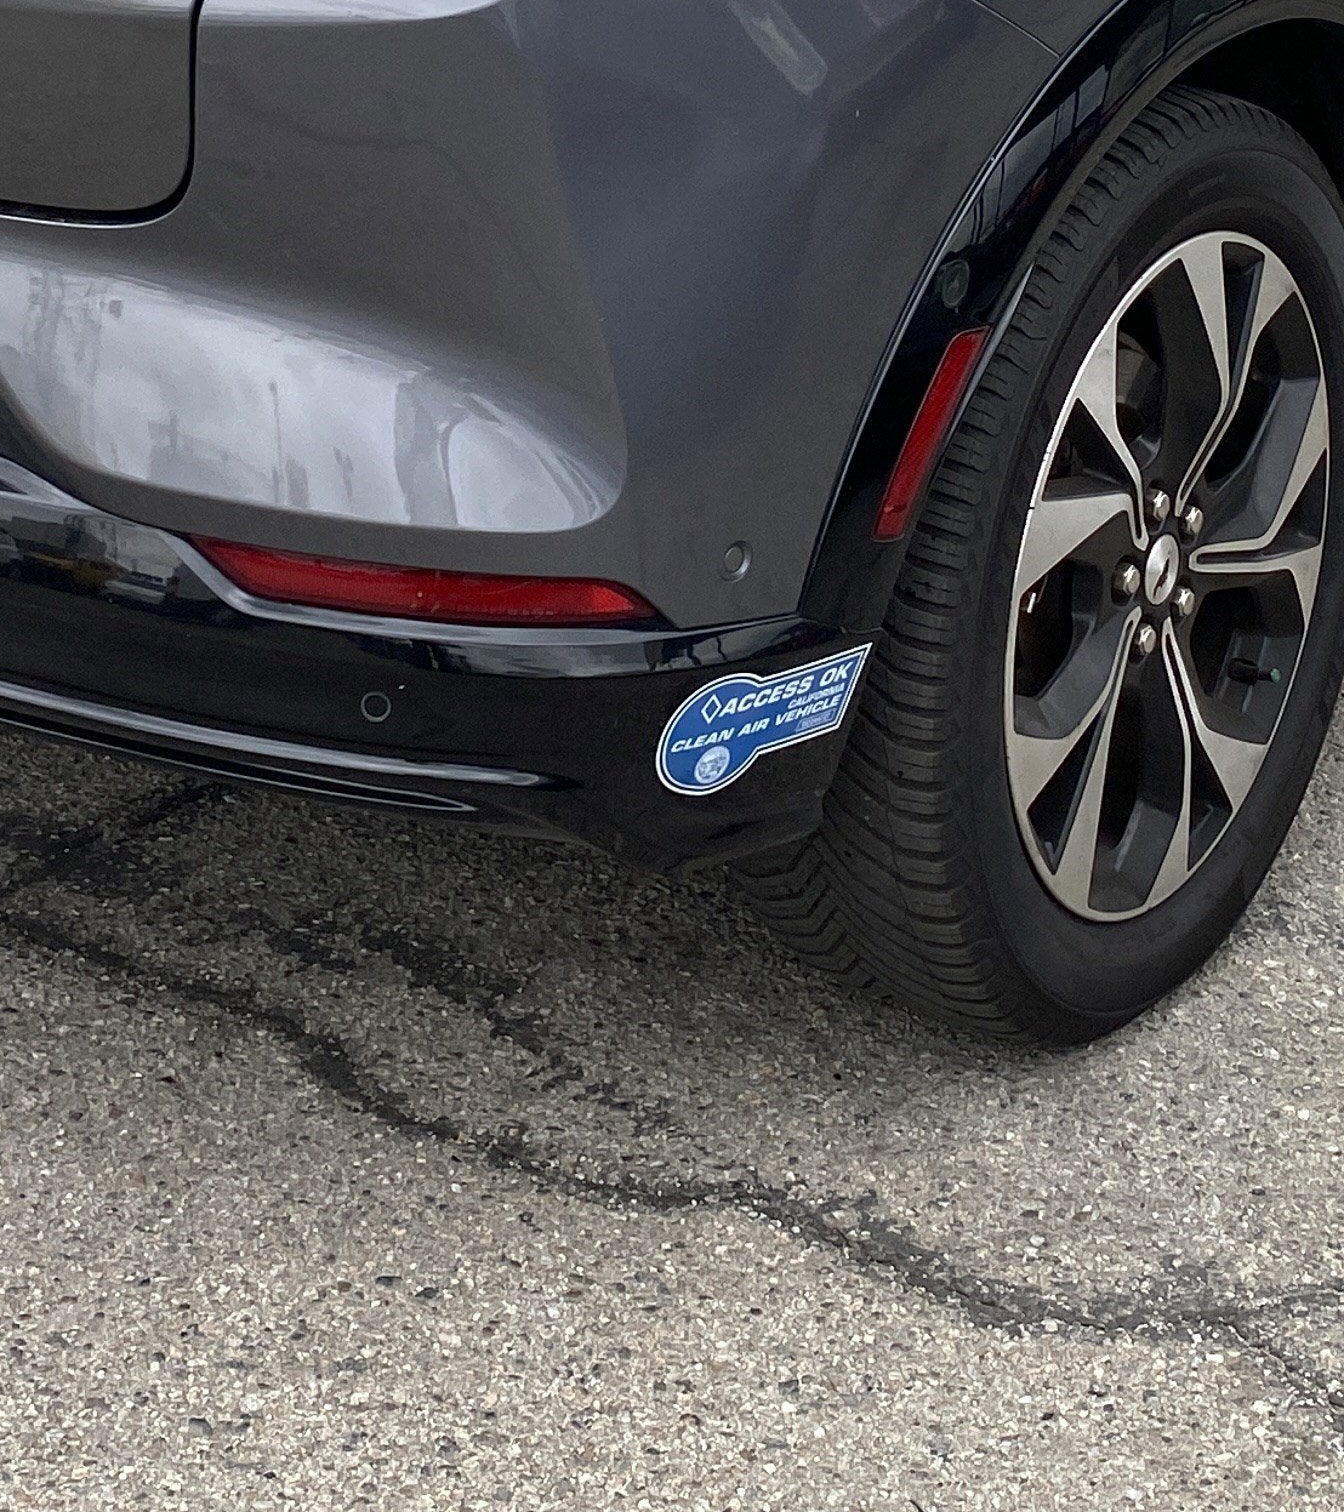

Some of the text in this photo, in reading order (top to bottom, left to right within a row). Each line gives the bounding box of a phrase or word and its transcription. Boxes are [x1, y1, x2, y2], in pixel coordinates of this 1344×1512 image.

[718, 661, 853, 718] ACCESS OK
[670, 727, 735, 753] CLEAN
[737, 718, 771, 738] AIR
[775, 694, 843, 726] VEHICLE
